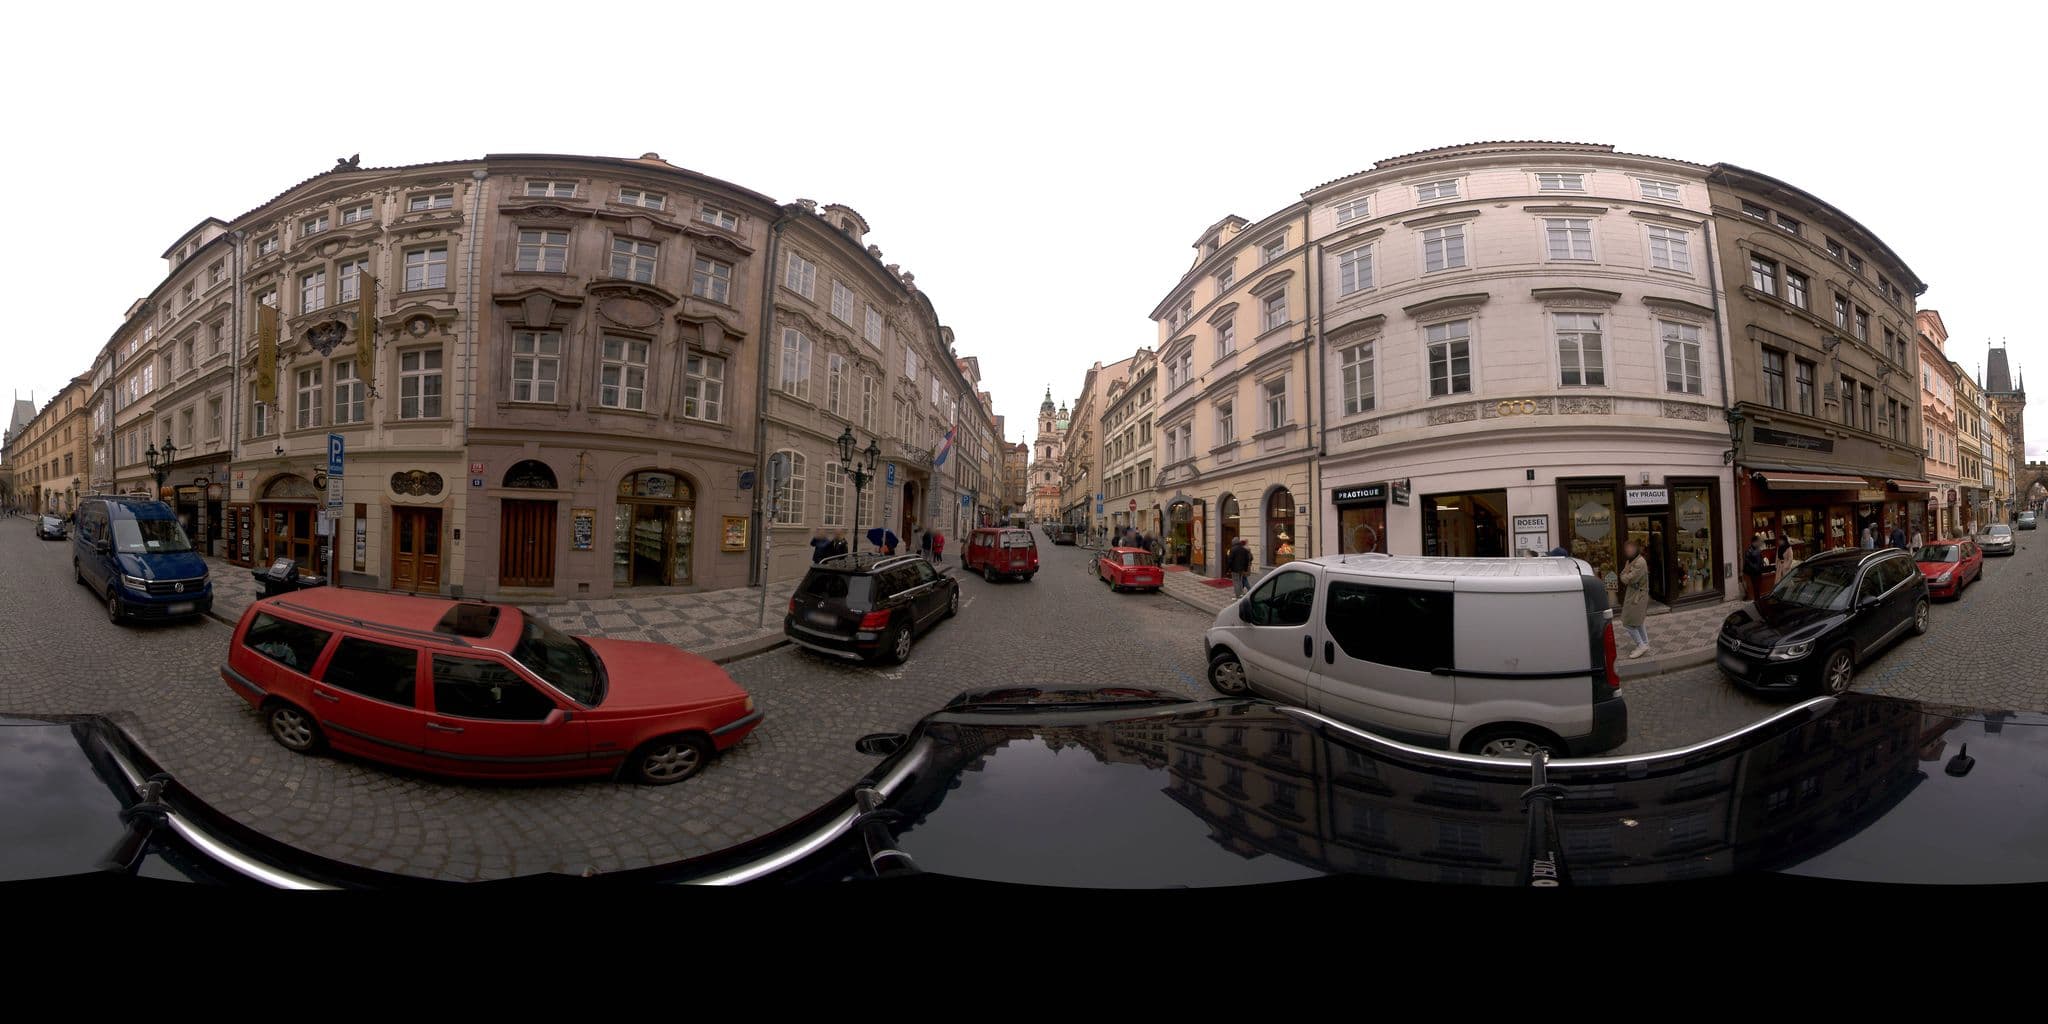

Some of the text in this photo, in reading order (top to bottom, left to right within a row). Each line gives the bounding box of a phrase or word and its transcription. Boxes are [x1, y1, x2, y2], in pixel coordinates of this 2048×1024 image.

[332, 439, 341, 463] P
[1338, 488, 1380, 500] PRAGTIQUE
[1640, 490, 1666, 498] PRAGUE
